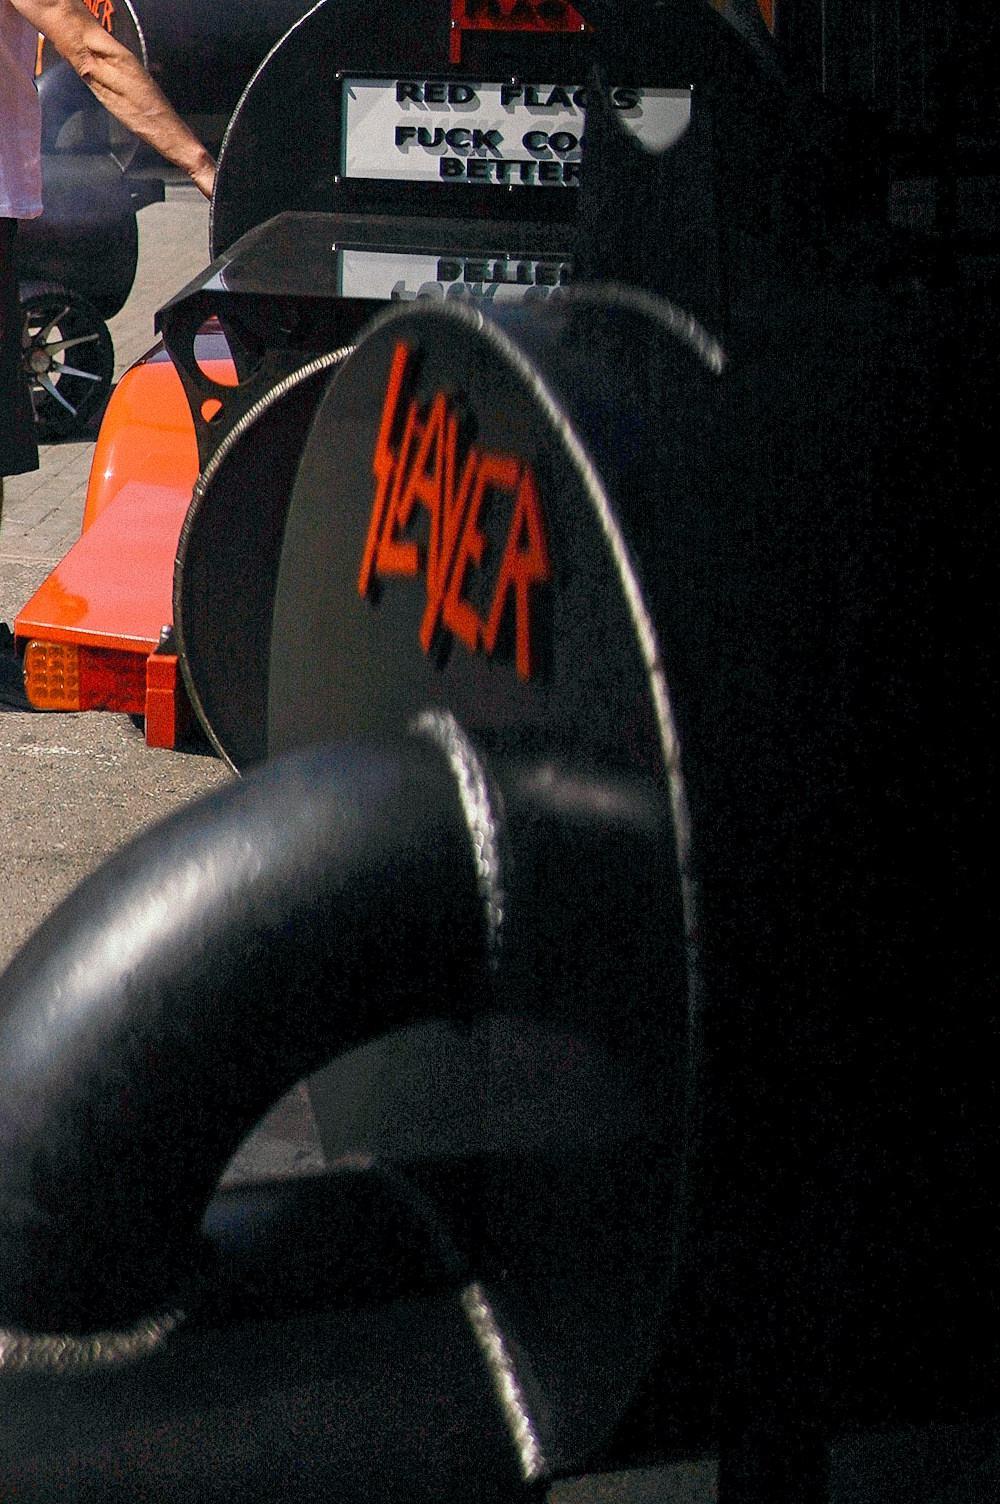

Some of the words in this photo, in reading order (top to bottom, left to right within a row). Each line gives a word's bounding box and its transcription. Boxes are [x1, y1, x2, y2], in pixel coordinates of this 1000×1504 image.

[396, 81, 476, 105] RED
[395, 126, 504, 155] FUCK
[522, 130, 587, 152] CO
[439, 157, 581, 182] BETTER
[357, 338, 553, 683] SLAYER
